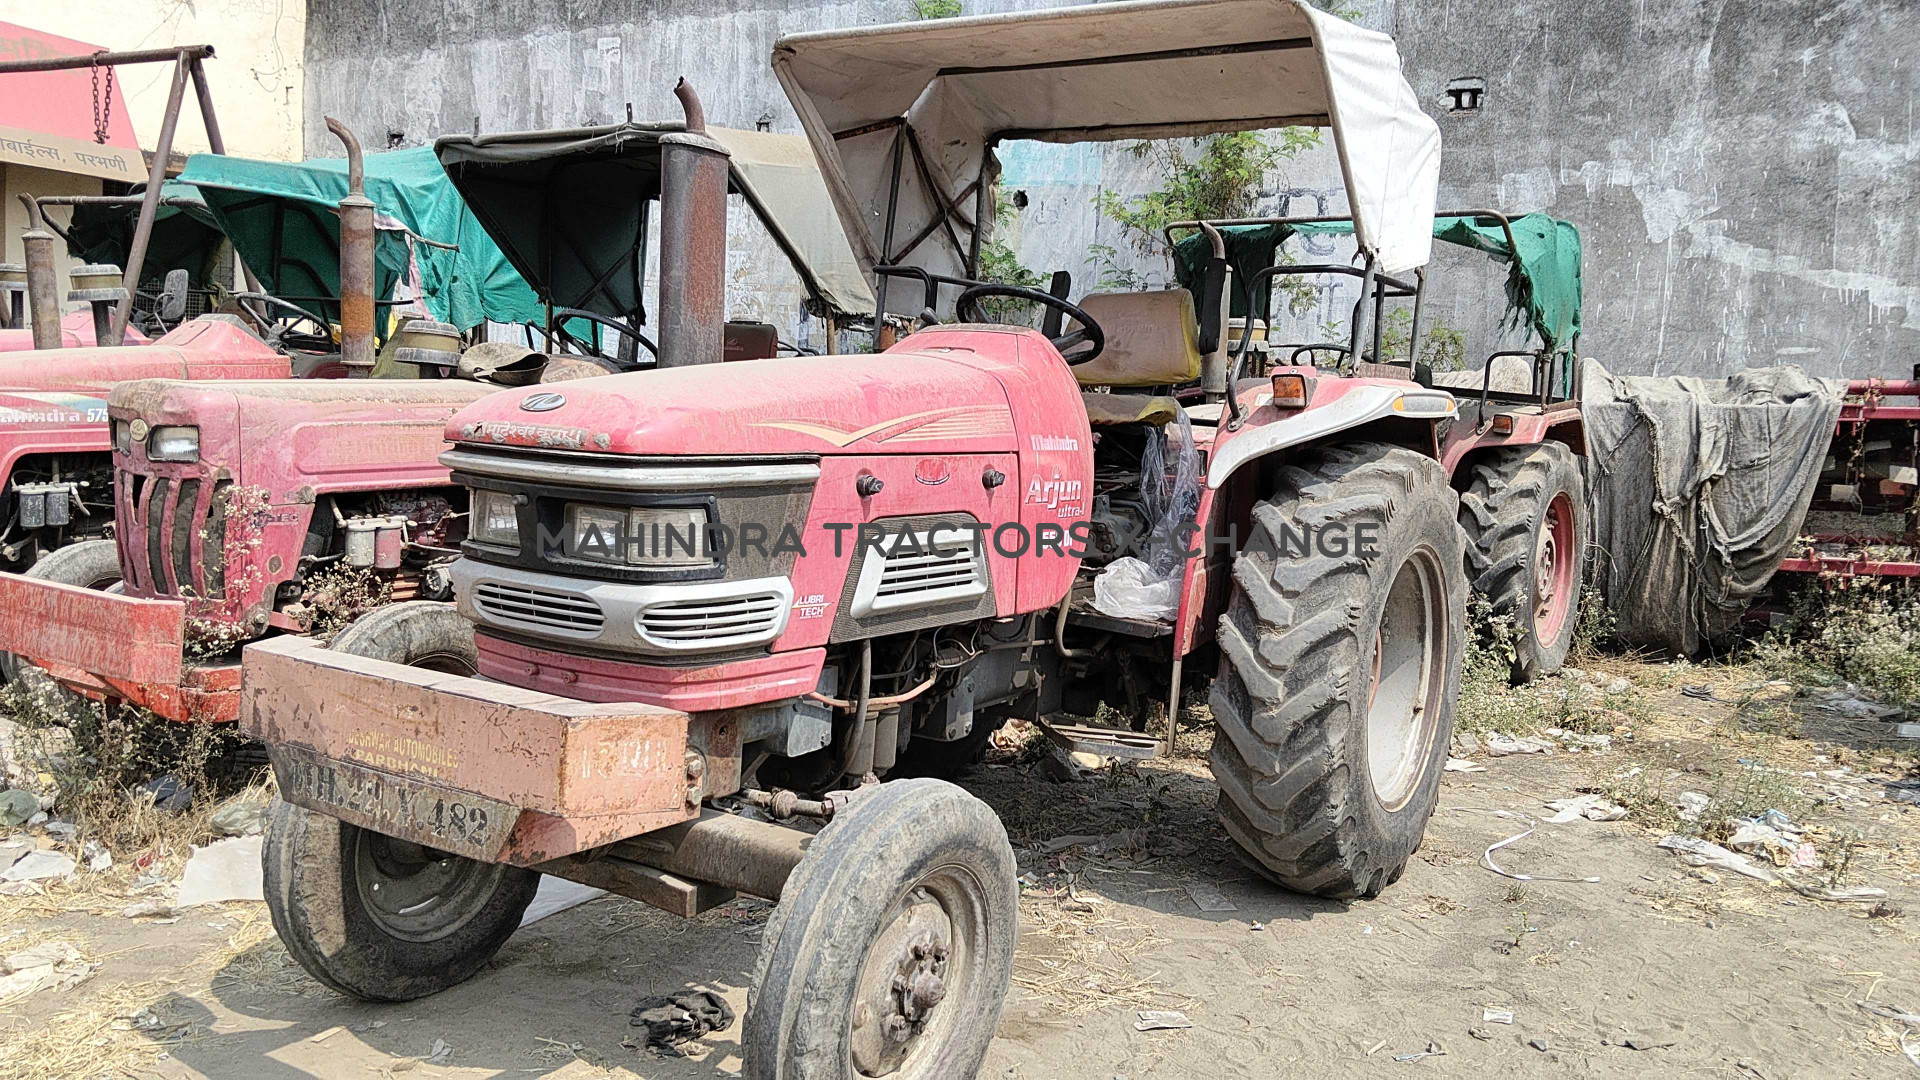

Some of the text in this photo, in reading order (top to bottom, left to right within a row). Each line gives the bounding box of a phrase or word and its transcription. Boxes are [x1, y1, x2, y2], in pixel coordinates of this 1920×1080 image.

[74, 151, 128, 172] परभणी
[0, 408, 80, 423] ahindra
[1030, 433, 1079, 452] Mahindra
[1024, 473, 1082, 511] Arjun
[799, 594, 825, 605] LUBRI
[799, 606, 824, 618] TECH
[354, 749, 439, 778] PARBHANI
[393, 738, 460, 769] AUTOMOBILES
